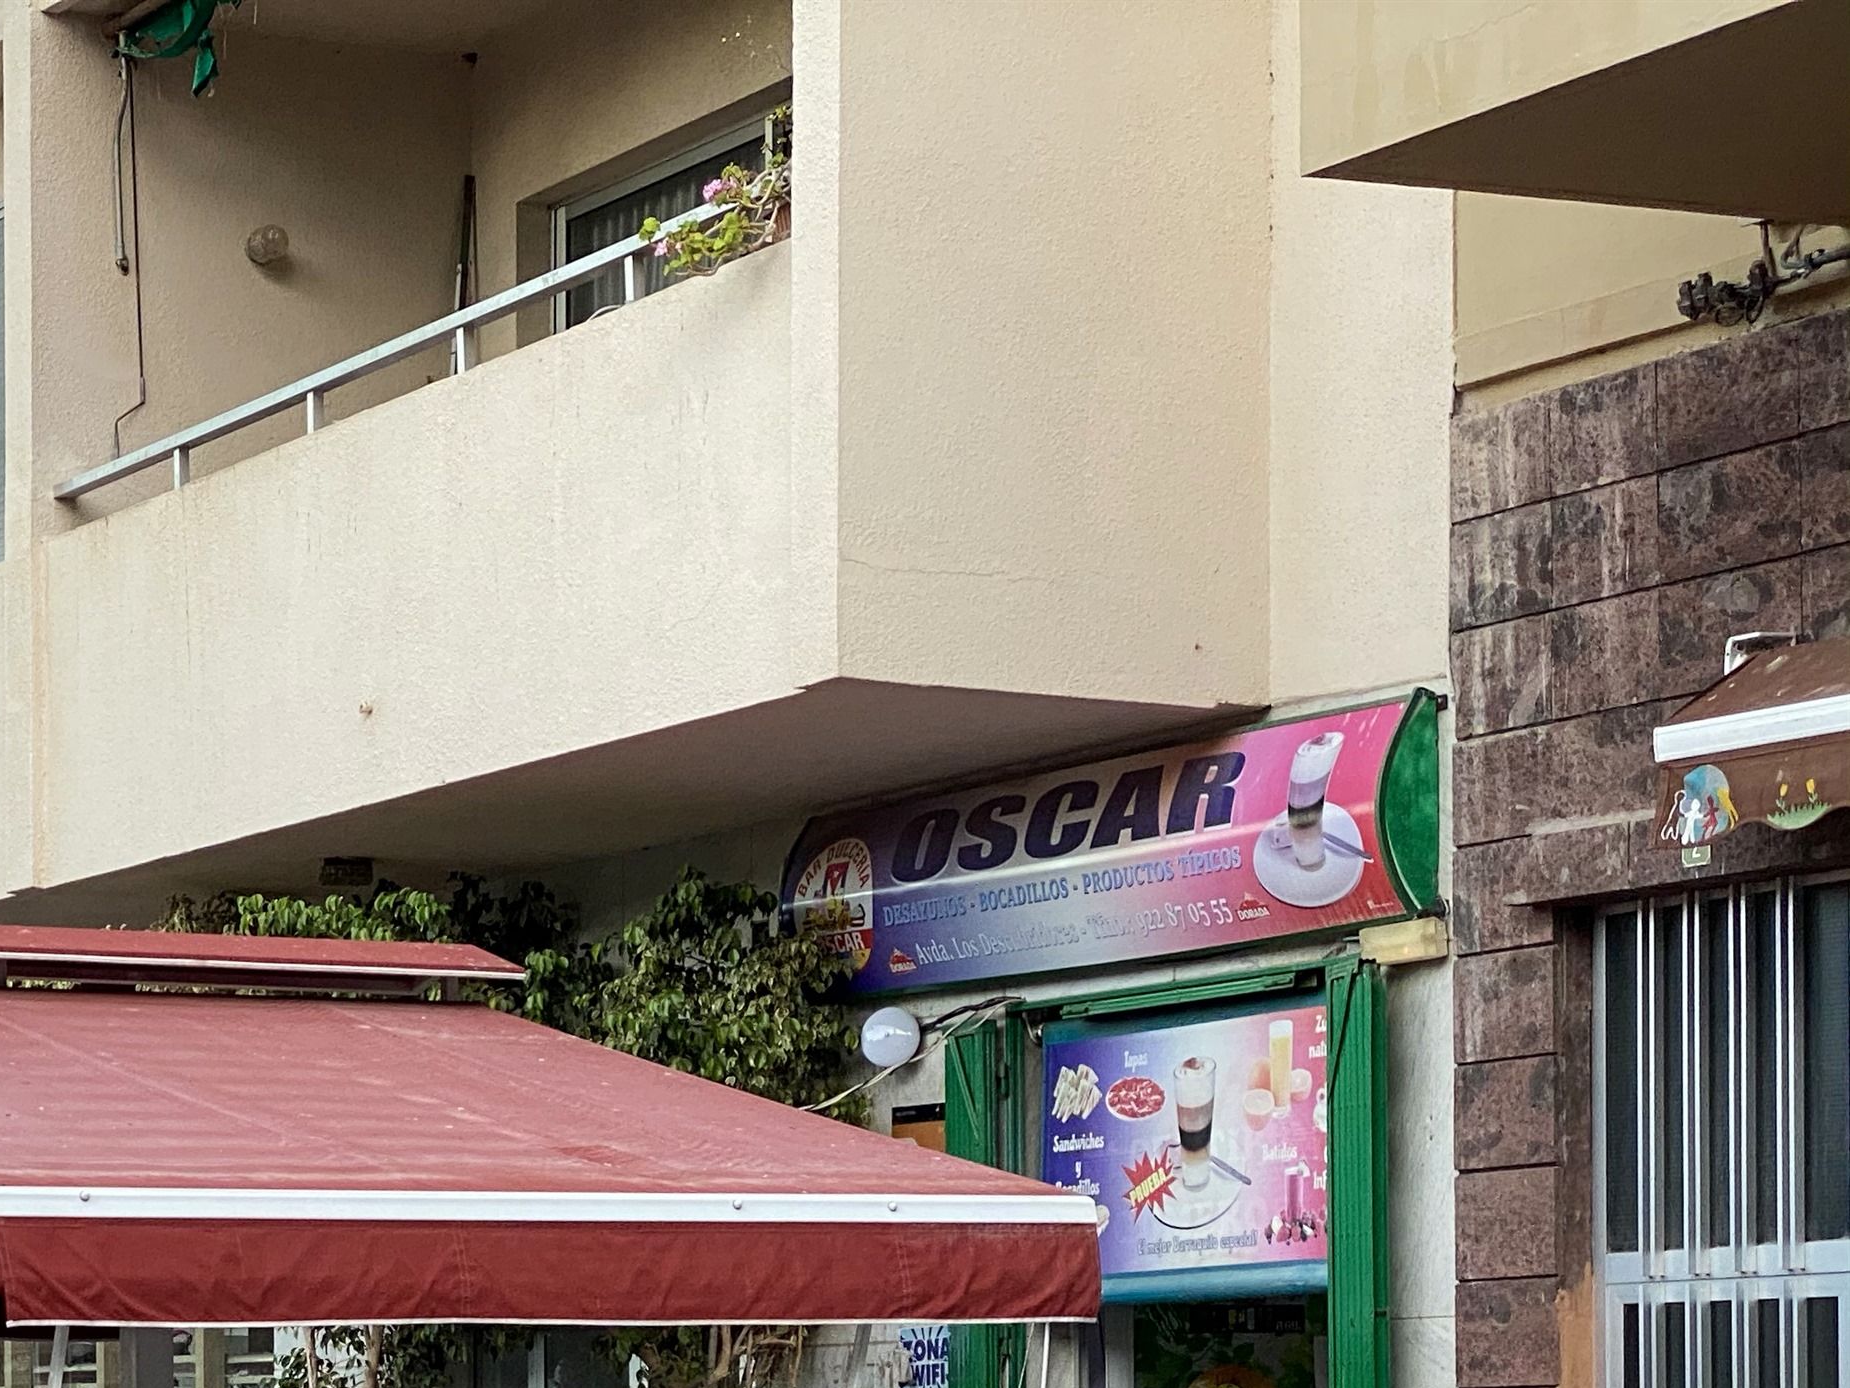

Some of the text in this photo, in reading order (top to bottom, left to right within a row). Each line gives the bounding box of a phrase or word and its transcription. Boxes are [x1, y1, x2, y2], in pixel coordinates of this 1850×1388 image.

[890, 751, 1247, 883] OSCAR
[797, 860, 822, 898] BAR
[882, 896, 968, 927] DESAYUNOS
[978, 876, 1070, 913] BOCADILLOS
[1081, 860, 1175, 895] PRODUCTOS
[1177, 845, 1243, 879] TÍPICOS
[1236, 905, 1271, 922] DORADA
[824, 931, 865, 956] SCAR
[914, 938, 955, 966] Avda.
[951, 936, 980, 960] Los
[1135, 907, 1165, 938] 922
[1164, 901, 1186, 931] 87
[1187, 901, 1211, 927] 05
[1210, 897, 1234, 925] 55
[1123, 1050, 1149, 1074] Tapas
[1052, 1131, 1105, 1153] Sandwiches
[1074, 1160, 1082, 1179] y
[1129, 1167, 1168, 1207] PRUEBA
[910, 1362, 946, 1387] WIFI
